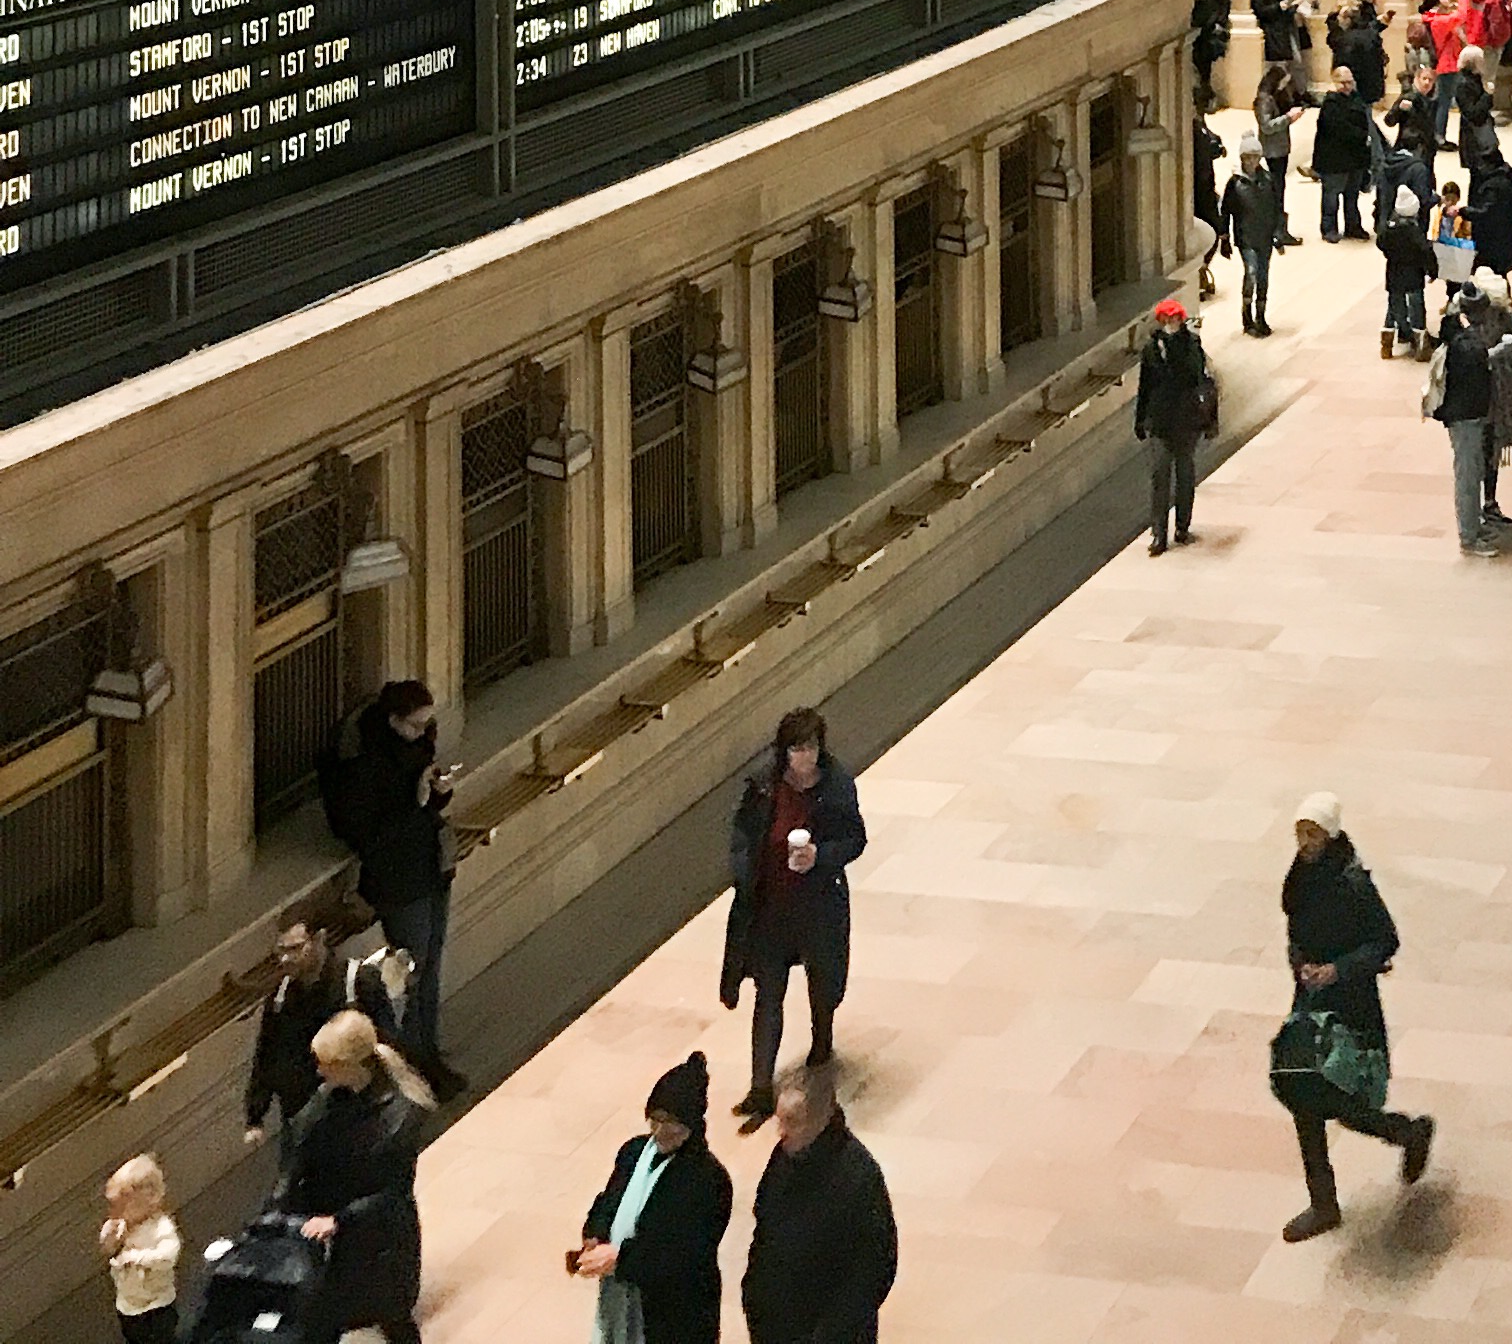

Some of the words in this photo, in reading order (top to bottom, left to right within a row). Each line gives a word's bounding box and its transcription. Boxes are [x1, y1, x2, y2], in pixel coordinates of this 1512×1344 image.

[130, 32, 212, 77] STAMFORD
[242, 16, 269, 47] 1ST
[278, 4, 315, 36] STOP
[515, 56, 547, 86] 2:34
[573, 42, 588, 67] 23
[600, 31, 622, 58] NEW
[626, 18, 660, 49] HAVEN
[573, 6, 588, 30] 19
[130, 84, 182, 122] MOUNT
[191, 64, 251, 104] VERNON
[280, 49, 306, 78] 1ST
[314, 37, 350, 68] STOP
[130, 113, 232, 168] CONNECTION
[242, 104, 260, 132] TO
[269, 94, 297, 125] NEW
[305, 75, 359, 113] CANAAN
[383, 45, 456, 88] WATERBURY
[130, 173, 183, 214] MOUNT
[192, 150, 252, 192] VERNON
[280, 132, 307, 164] 1ST
[315, 118, 351, 151] STOP
